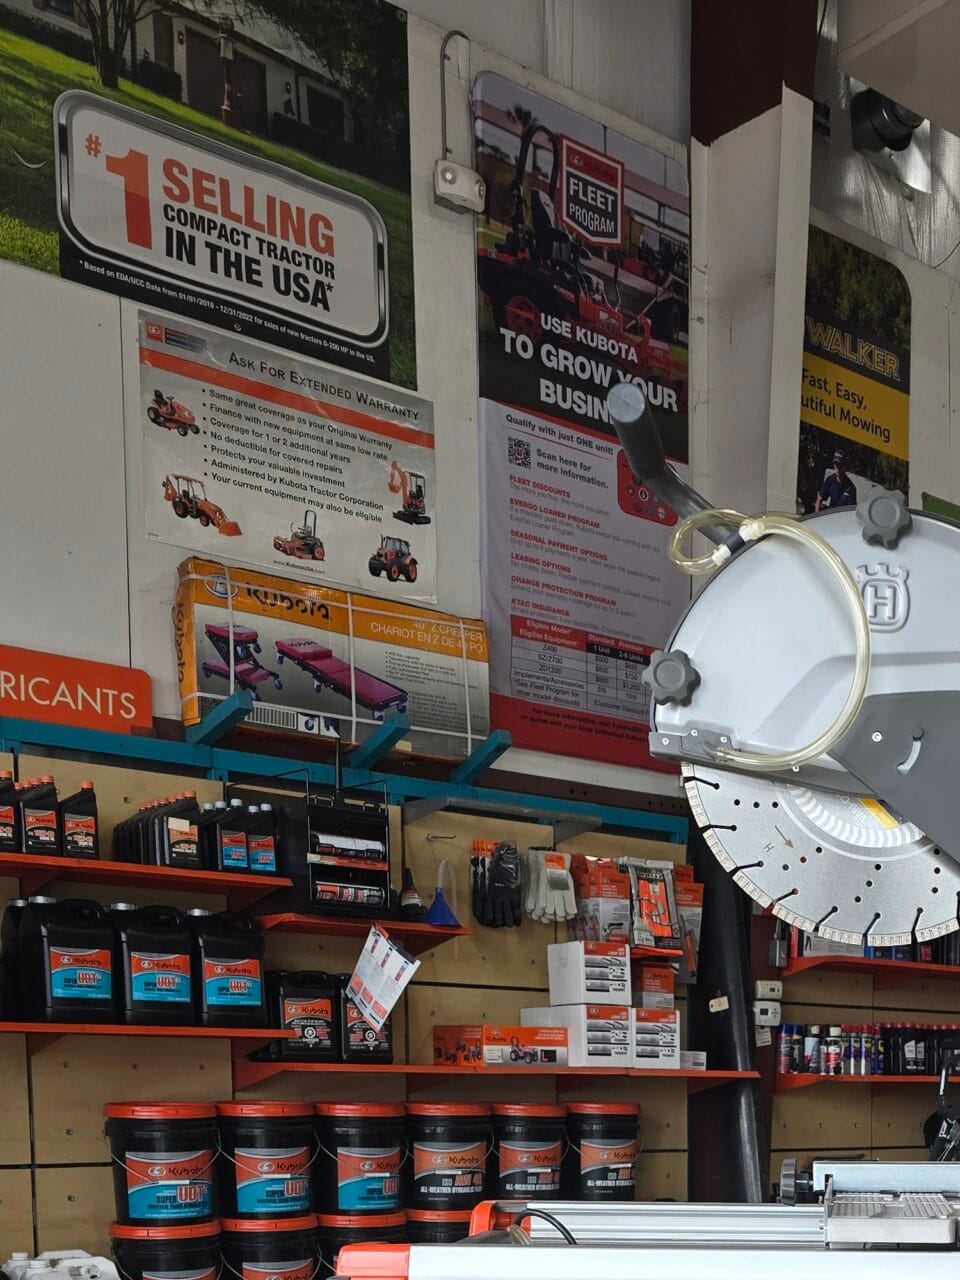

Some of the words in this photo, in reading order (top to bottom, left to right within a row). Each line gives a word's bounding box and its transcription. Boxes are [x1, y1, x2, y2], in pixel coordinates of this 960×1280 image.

[162, 158, 335, 257] SELLING
[569, 177, 615, 213] FLEET
[569, 203, 615, 233] PROGRAM
[163, 204, 252, 250] COMPACT
[256, 236, 336, 280] TRACTOR
[165, 226, 196, 266] IN
[204, 240, 262, 288] THE
[84, 260, 105, 275] Based
[106, 269, 115, 278] on
[115, 272, 145, 288] EDA/UCC
[145, 281, 162, 293] Data
[162, 287, 178, 299] from
[220, 304, 253, 321] 12/31/2022
[254, 316, 264, 325] for
[264, 319, 279, 331] sales
[287, 328, 299, 337] new
[300, 332, 322, 346] tractors
[500, 327, 534, 360] TO
[540, 343, 613, 388] GROW
[540, 312, 573, 338] USE
[575, 326, 639, 364] KUBOTA
[805, 316, 900, 380] WALKER
[802, 368, 832, 396] Fast,
[835, 382, 868, 410] Easy,
[209, 389, 233, 403] Same
[235, 398, 257, 411] great
[258, 406, 295, 422] coverage
[297, 417, 306, 425] as
[308, 420, 326, 431] your
[327, 424, 357, 439] Original
[359, 433, 393, 451] Warranty
[210, 403, 242, 419] Finance
[244, 415, 262, 425] with
[263, 421, 280, 431] new
[281, 426, 325, 444] equipment
[325, 438, 334, 446] at
[335, 441, 356, 452] same
[357, 446, 371, 456] low
[373, 451, 388, 461] rate
[210, 417, 250, 435] Coverage
[251, 429, 264, 438] for
[272, 436, 281, 444] or
[282, 438, 288, 446] 2
[289, 441, 328, 457] additional
[329, 452, 351, 464] years
[506, 414, 536, 431] Qualify
[538, 425, 556, 437] with
[558, 430, 574, 443] just
[576, 437, 594, 449] ONE
[840, 409, 891, 443] Mowing
[210, 431, 222, 441] No
[224, 435, 268, 454] deductible
[269, 447, 281, 457] for
[282, 452, 314, 466] covered
[316, 462, 343, 475] repairs
[211, 445, 246, 461] Protects
[248, 456, 266, 467] your
[267, 461, 300, 476] valuable
[302, 470, 345, 488] investment
[537, 448, 557, 462] Scan
[559, 455, 578, 468] here
[580, 461, 591, 472] for
[537, 461, 558, 474] more
[211, 459, 266, 480] Administered
[267, 473, 277, 484] by
[279, 477, 307, 491] Kubota
[309, 484, 337, 499] Tractor
[339, 493, 384, 511] Corporation
[211, 472, 231, 484] Your
[232, 479, 262, 491] current
[264, 487, 306, 505] equipment
[307, 498, 324, 510] may
[326, 503, 342, 513] also
[344, 506, 354, 516] be
[355, 510, 382, 523] eligible
[509, 475, 531, 487] FLEET
[532, 481, 571, 498] DISCOUNTS
[511, 552, 540, 565] LEASING
[371, 622, 415, 637] CHARIOT
[418, 631, 431, 644] EN
[432, 634, 442, 645] Z
[442, 637, 455, 648] DE
[470, 641, 484, 654] PO
[0, 670, 137, 719] RICANTS
